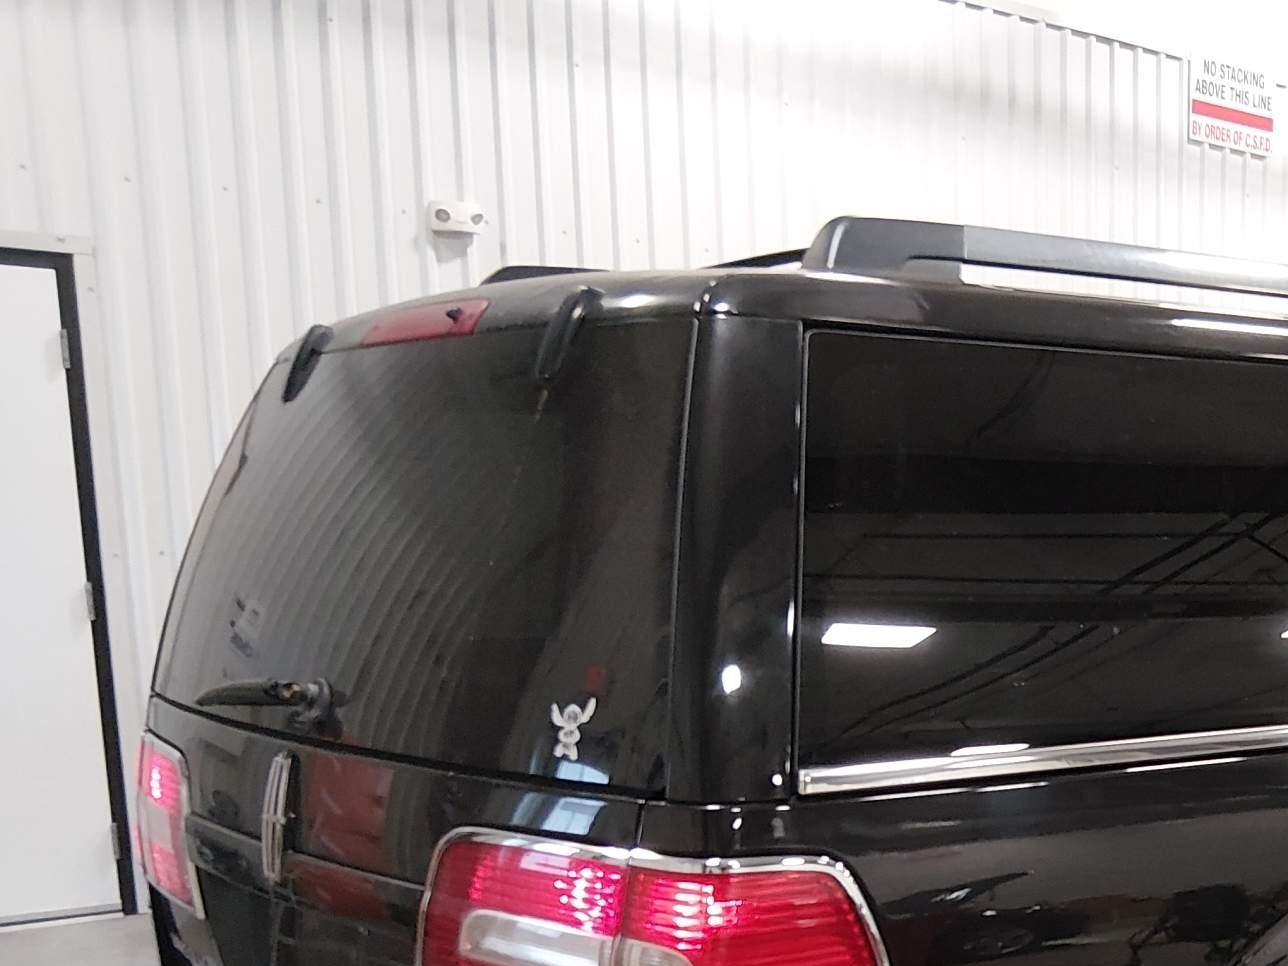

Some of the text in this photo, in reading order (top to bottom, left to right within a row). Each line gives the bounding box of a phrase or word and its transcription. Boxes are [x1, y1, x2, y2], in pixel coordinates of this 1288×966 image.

[1203, 59, 1265, 89] NO STACKING
[1195, 79, 1272, 112] ABOVE THIS LINE
[1191, 120, 1202, 136] BY
[1204, 123, 1232, 144] ORDER
[1233, 130, 1243, 147] OF
